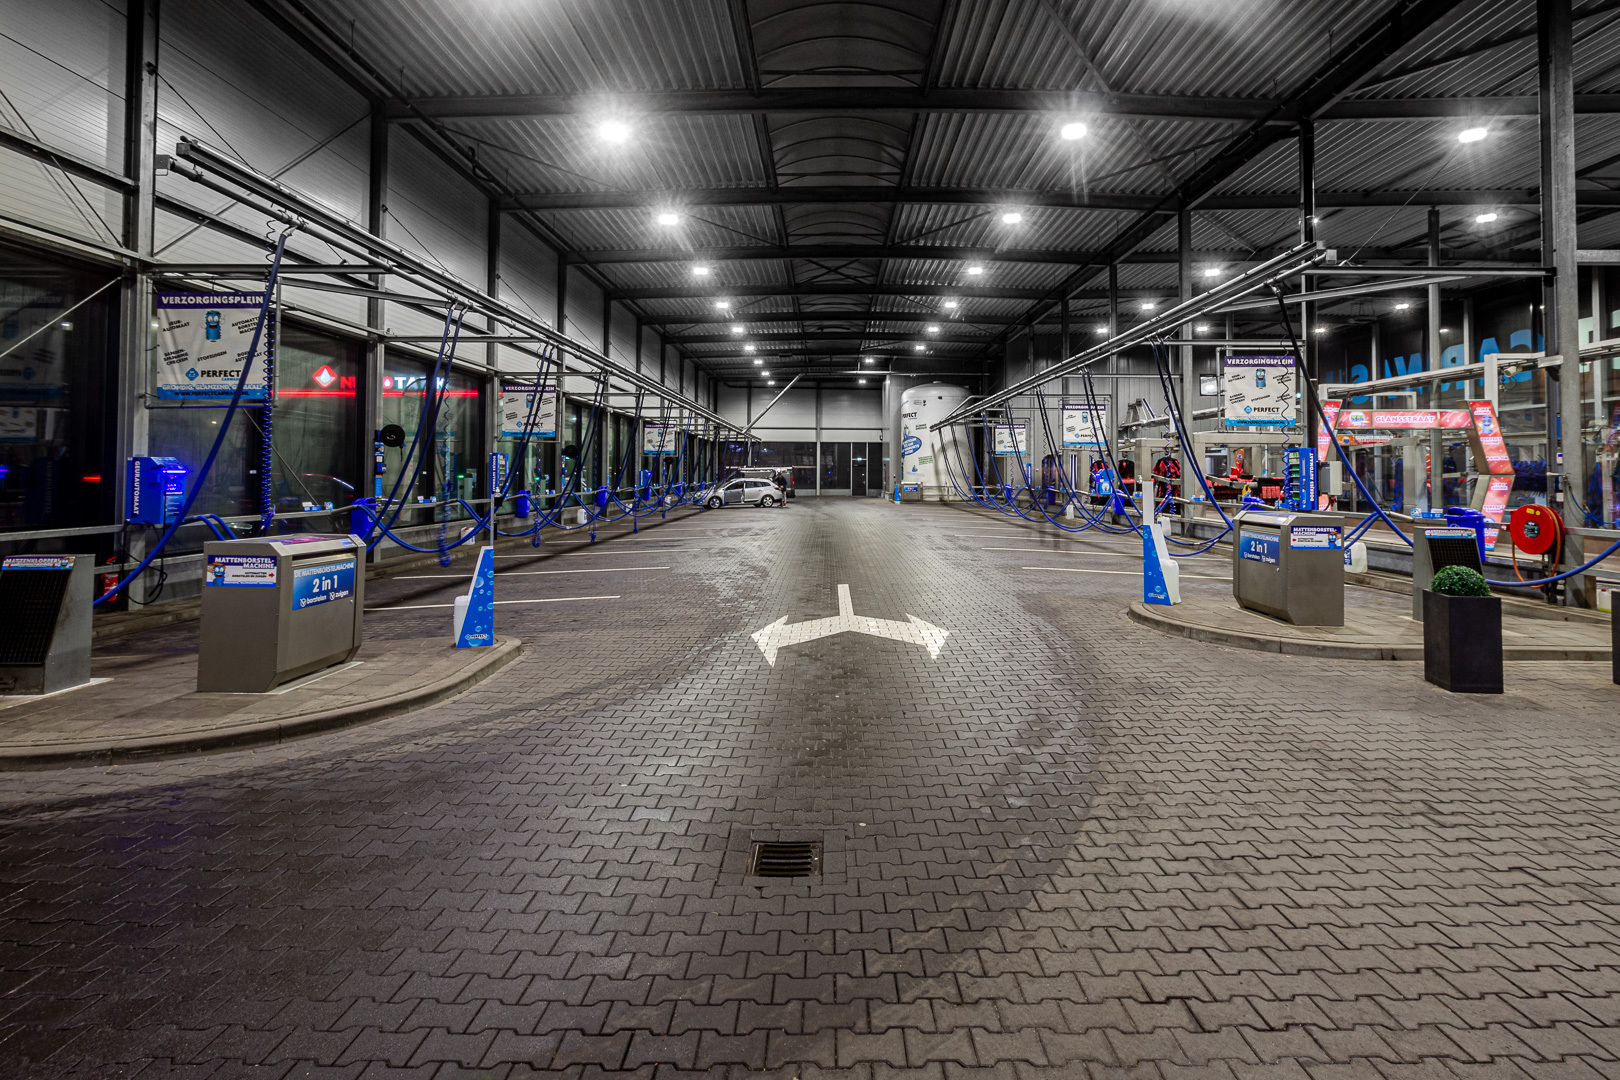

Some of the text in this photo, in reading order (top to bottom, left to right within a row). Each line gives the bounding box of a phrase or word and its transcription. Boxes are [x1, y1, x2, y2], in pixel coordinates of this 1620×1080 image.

[161, 296, 264, 305] VERZORGINGSPLEIN
[162, 322, 190, 332] AUTOMAAT
[200, 370, 241, 378] PERFECT
[1375, 415, 1436, 424] GLANSSTRAAT
[133, 460, 141, 515] GEURAUTOMAAT
[1250, 541, 1268, 554] 2 in 1
[301, 562, 355, 577] MATTENBORSTELMACHINE
[312, 575, 338, 593] 2 in 1
[306, 590, 349, 605] borstelen zuigen
